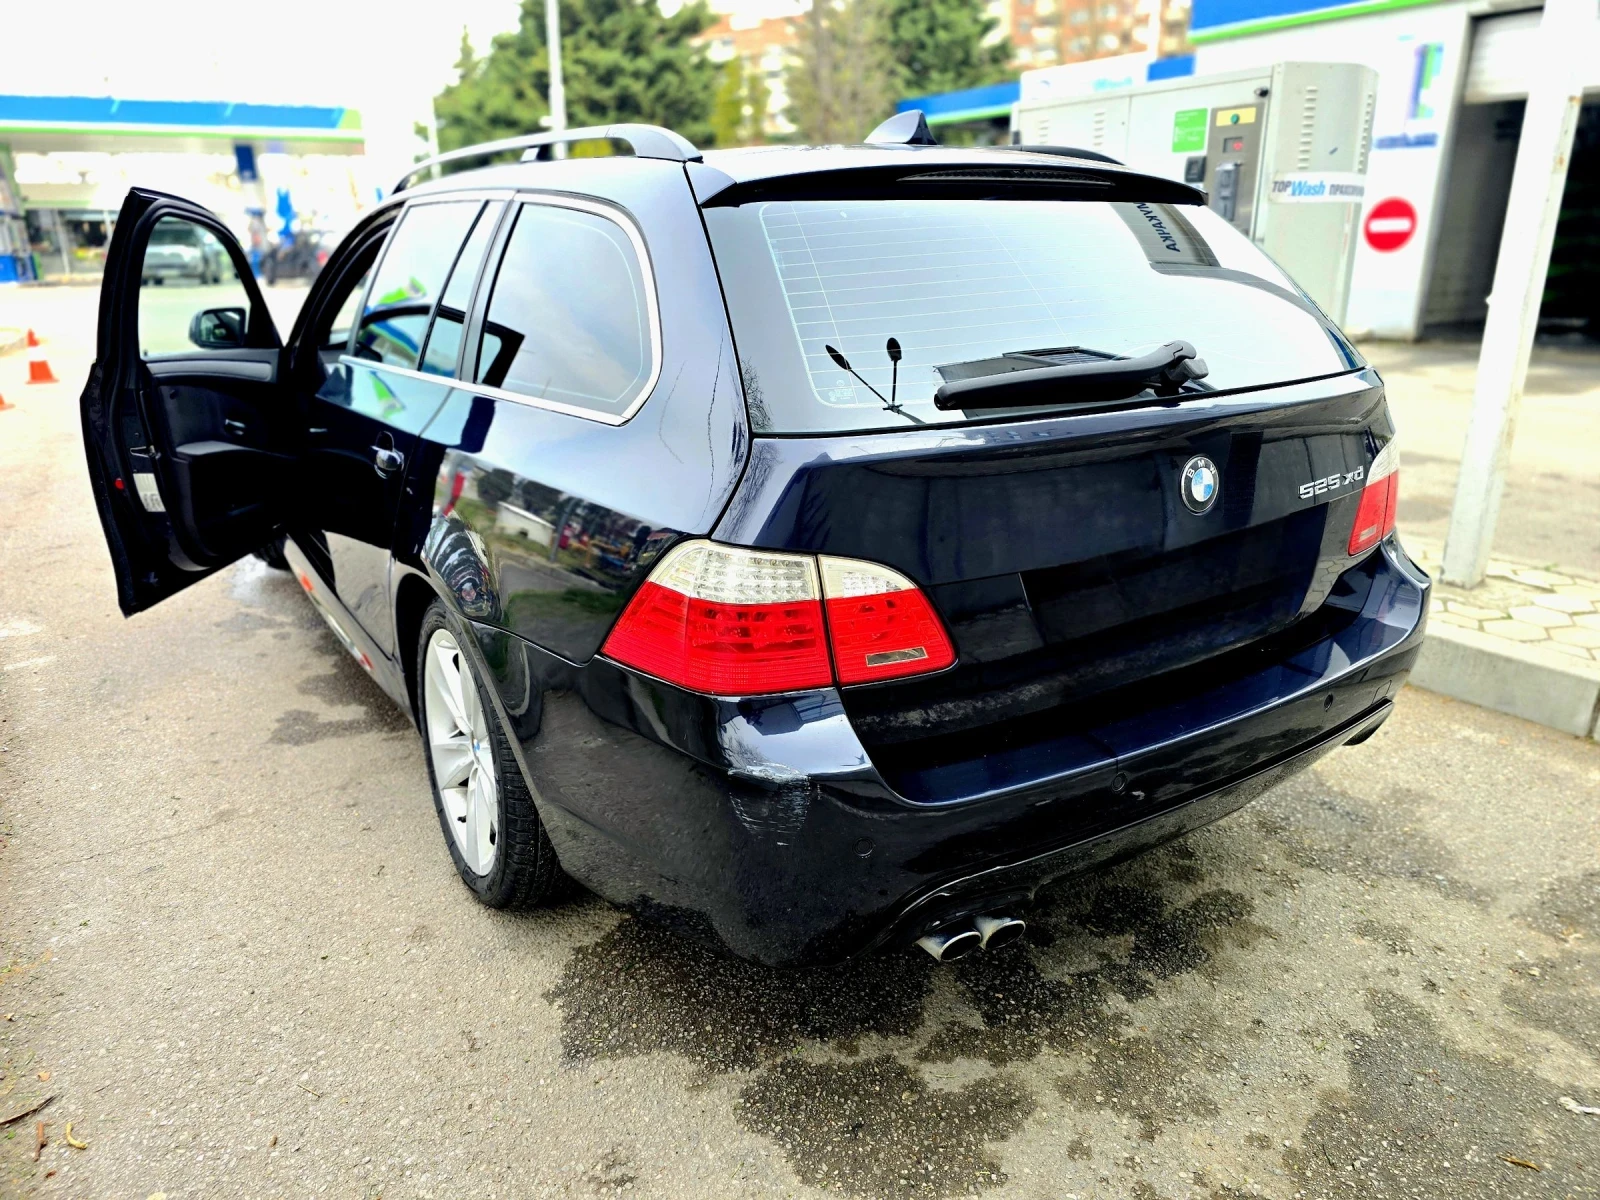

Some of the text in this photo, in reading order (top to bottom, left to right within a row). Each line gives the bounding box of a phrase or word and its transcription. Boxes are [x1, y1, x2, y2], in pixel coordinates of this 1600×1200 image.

[1187, 459, 1216, 479] BMW
[1299, 465, 1364, 500] 525 xd
